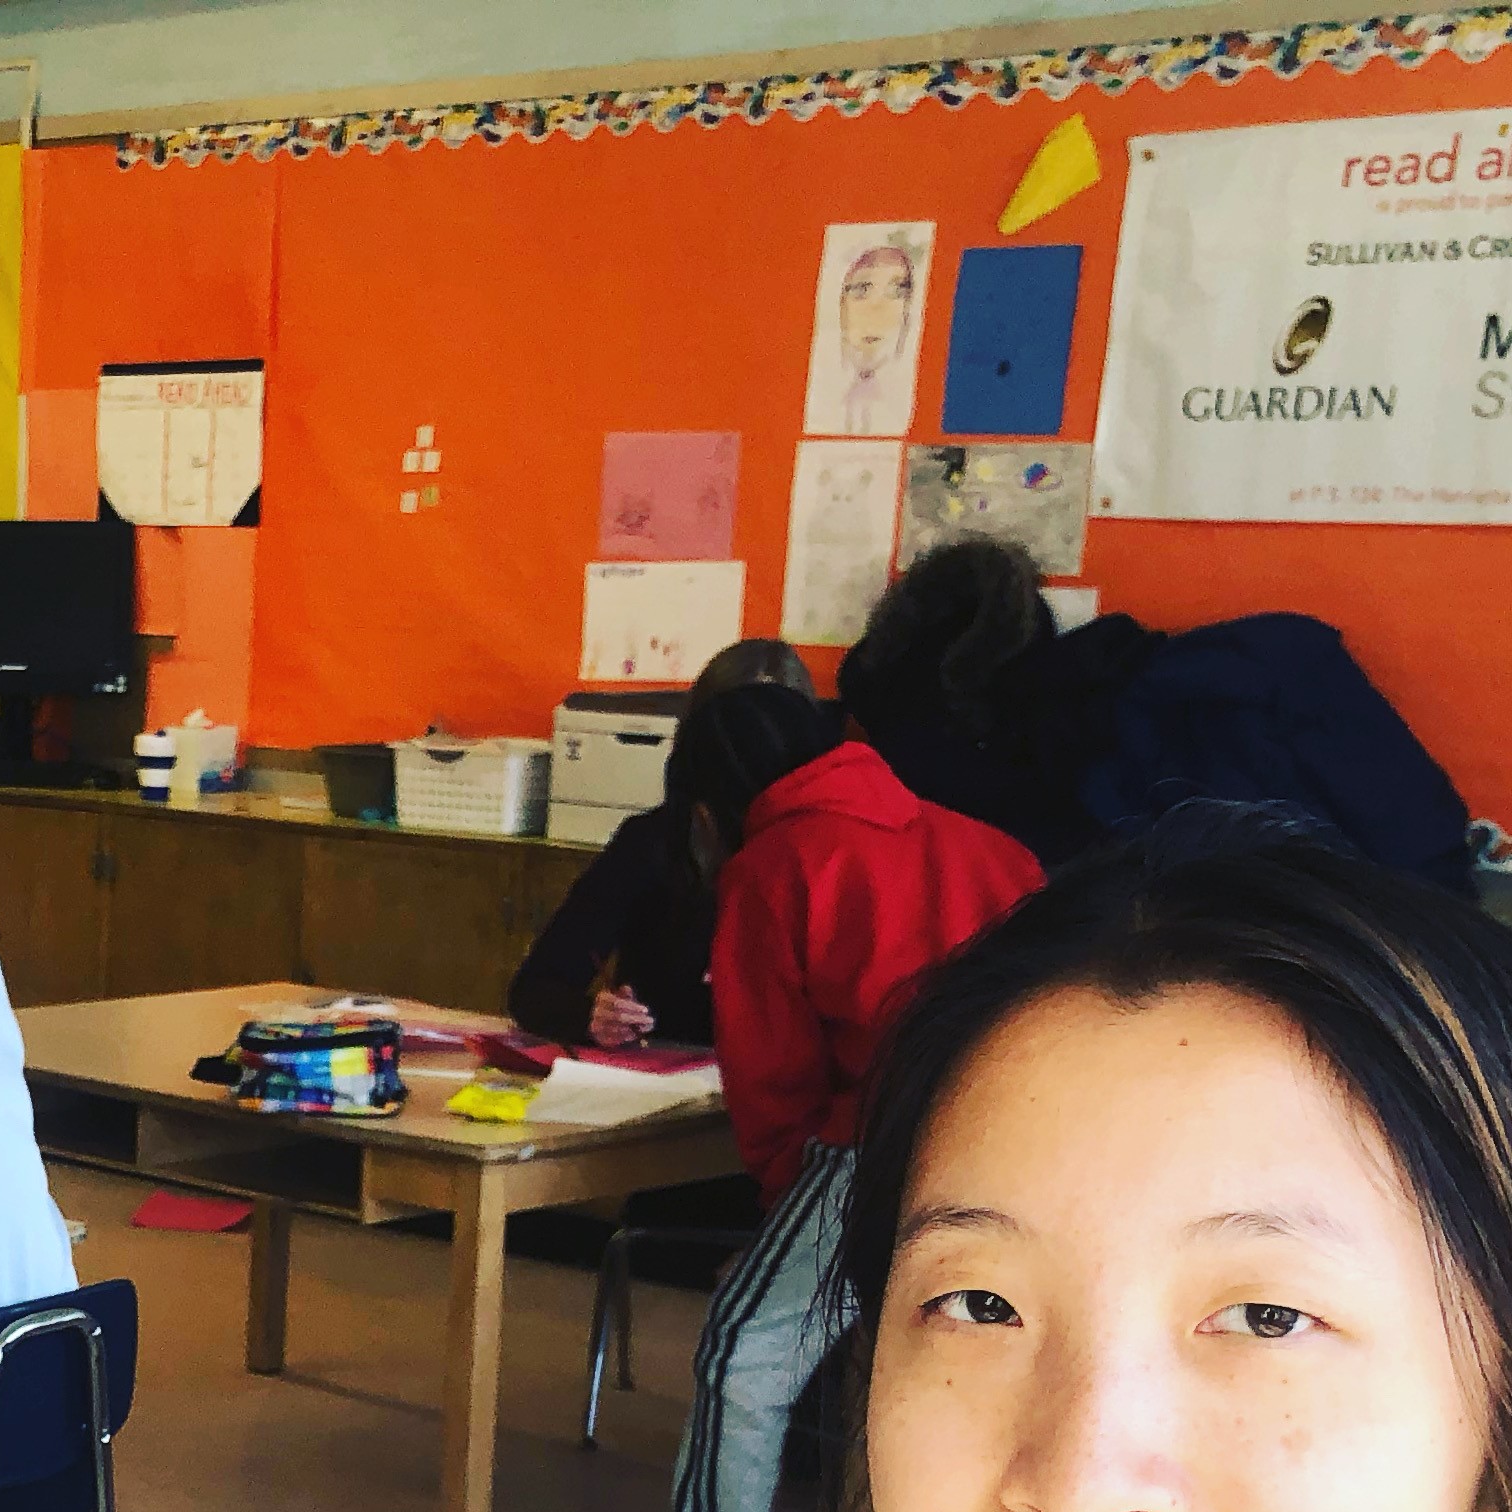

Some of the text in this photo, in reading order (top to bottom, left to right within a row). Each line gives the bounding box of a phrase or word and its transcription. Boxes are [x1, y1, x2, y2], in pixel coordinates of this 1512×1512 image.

[1340, 131, 1512, 188] read a
[1306, 233, 1512, 267] SULLIVAN & CR
[1182, 384, 1399, 423] GUARDIAN
